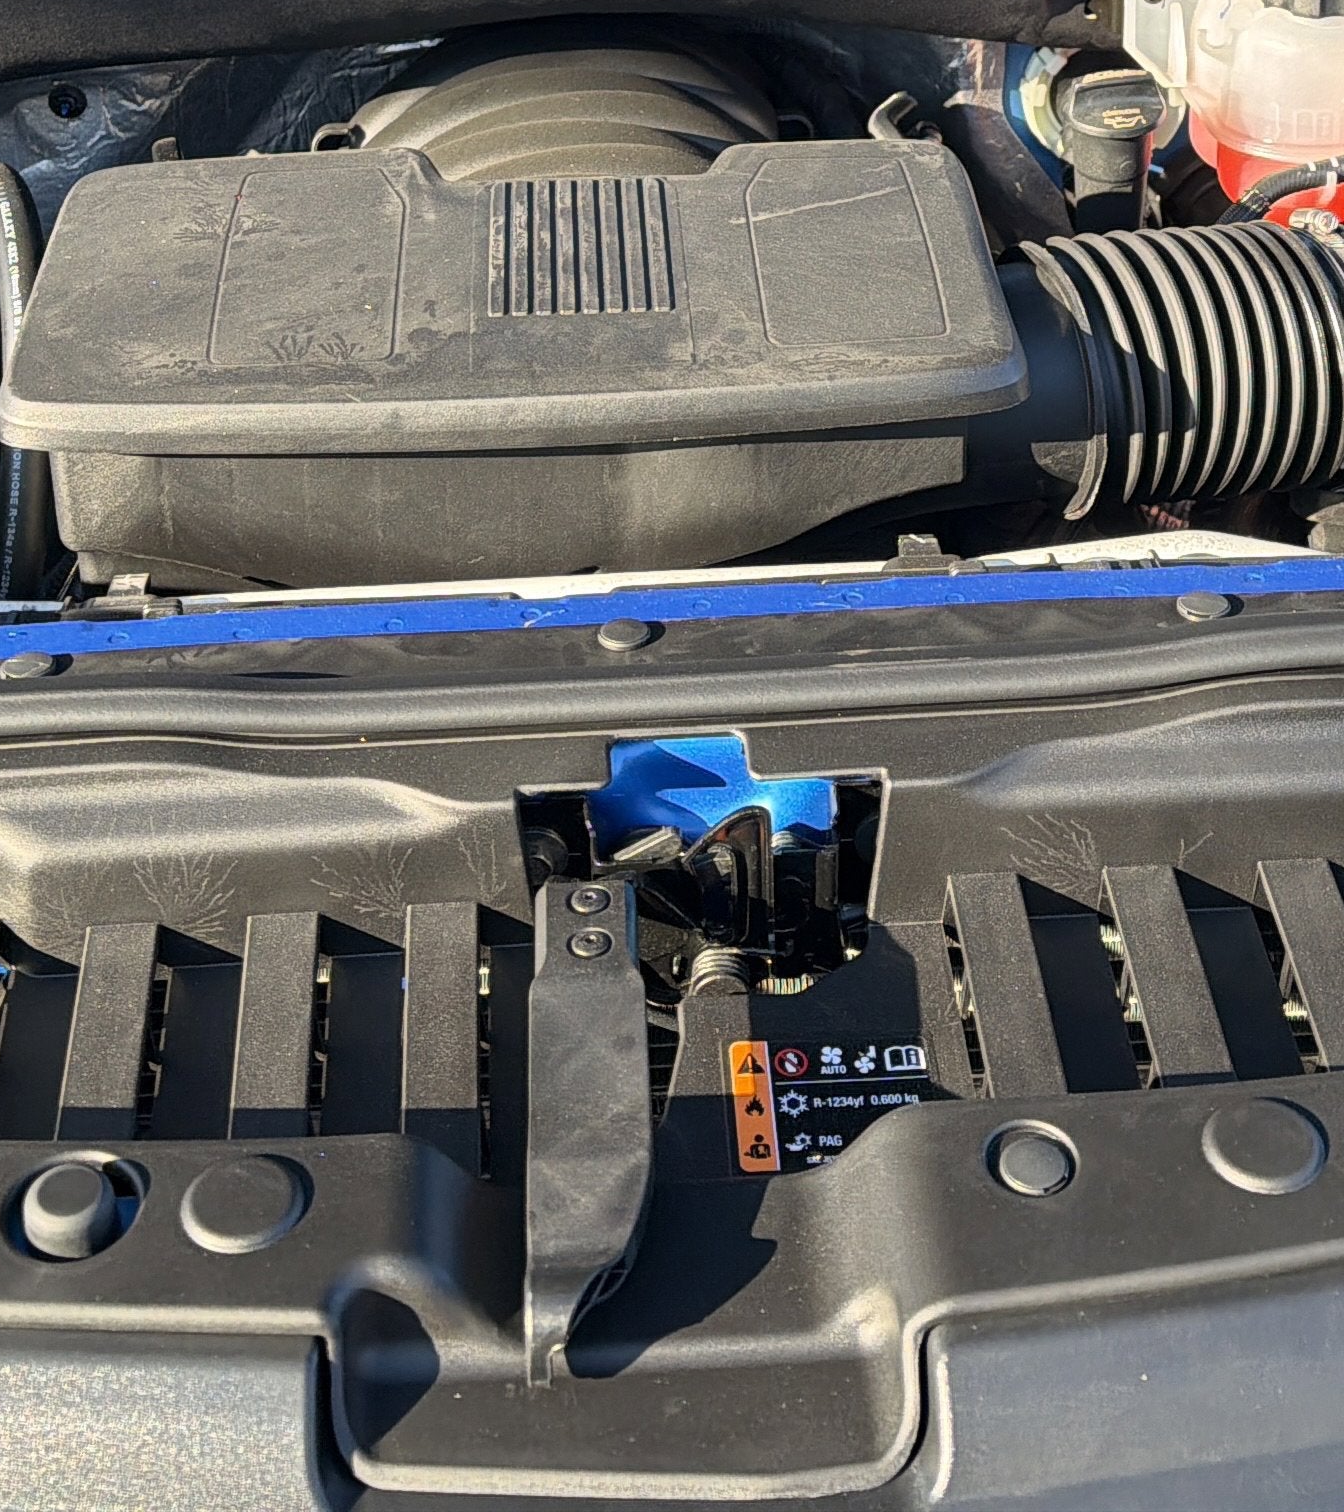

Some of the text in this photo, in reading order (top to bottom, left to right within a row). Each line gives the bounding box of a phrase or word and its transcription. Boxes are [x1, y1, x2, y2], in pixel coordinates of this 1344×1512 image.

[0, 201, 17, 238] GALAXY
[9, 472, 21, 505] HOSE
[5, 508, 18, 547] R-134a
[820, 1065, 847, 1075] AUTO
[813, 1093, 919, 1109] R-1234yf 0.600 kg
[818, 1134, 843, 1147] PAG
